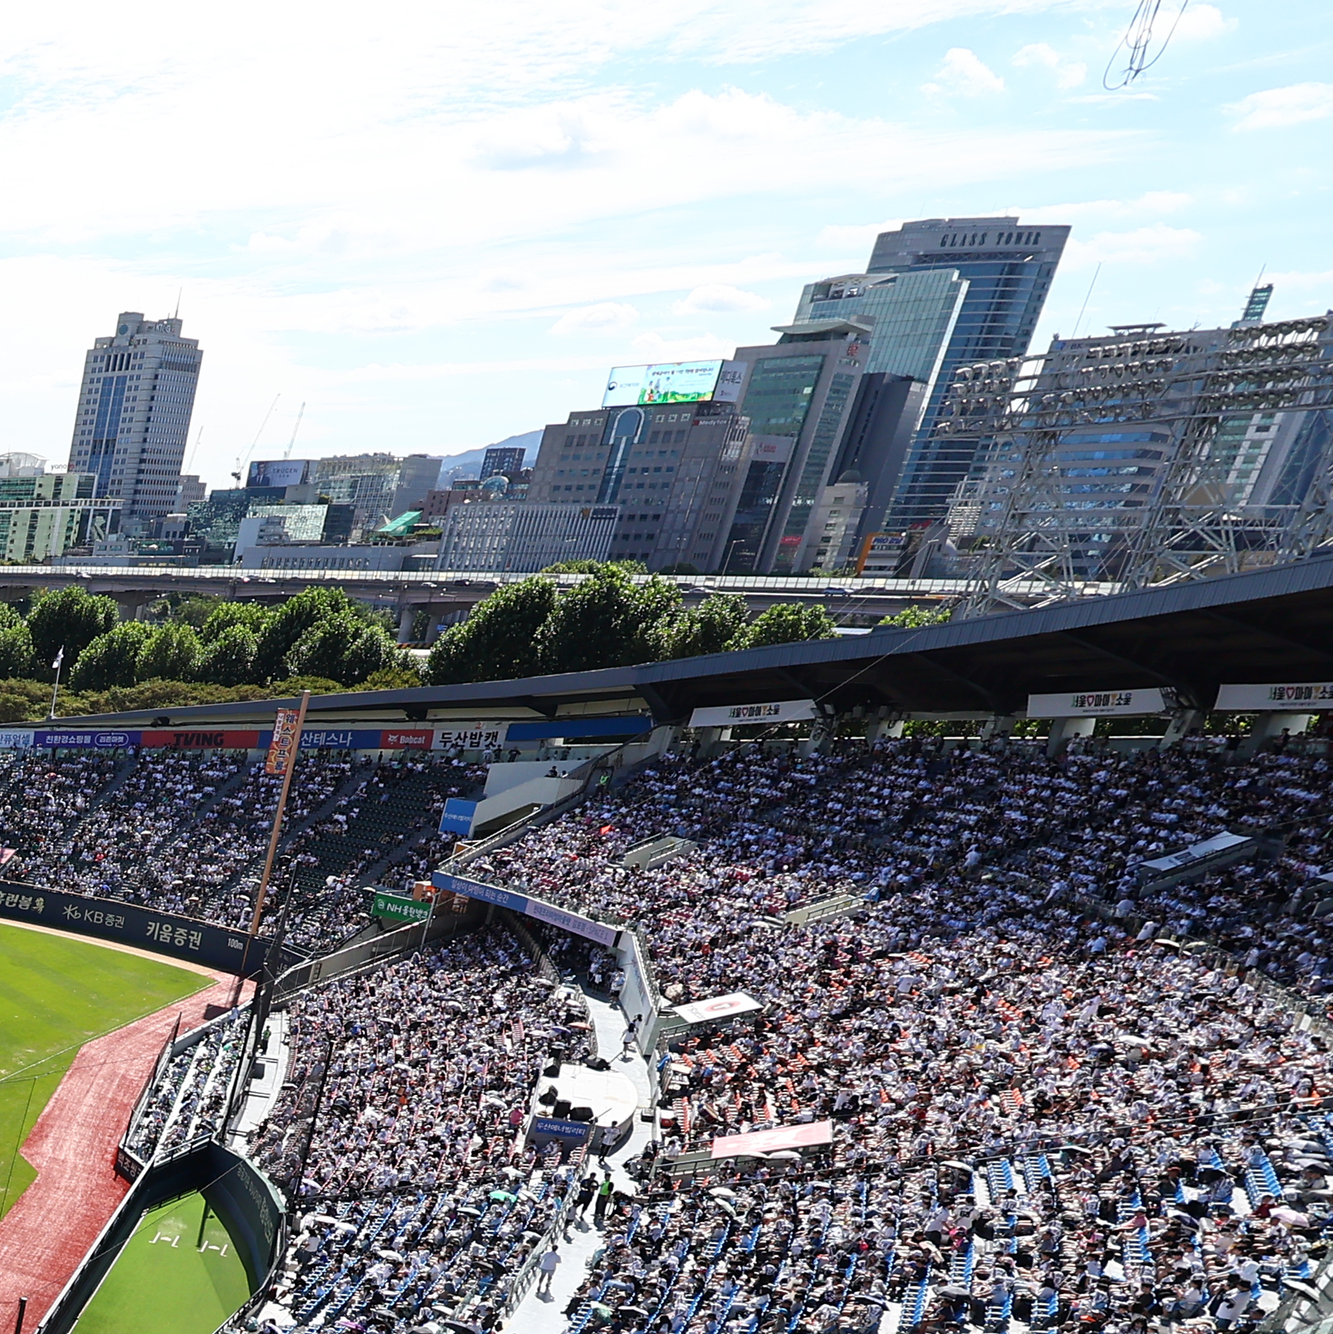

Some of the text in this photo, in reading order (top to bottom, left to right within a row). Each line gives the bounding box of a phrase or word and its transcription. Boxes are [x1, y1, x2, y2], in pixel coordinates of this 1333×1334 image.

[940, 231, 1041, 247] GLASS TOWER
[46, 735, 91, 744] 친환경쇼핑몰
[173, 733, 225, 746] TVING
[299, 731, 353, 747] 산테스나
[399, 735, 426, 744] Bobcat
[439, 731, 500, 749] 두산밥캣
[145, 921, 203, 950] 키움증권
[227, 938, 244, 950] 100m
